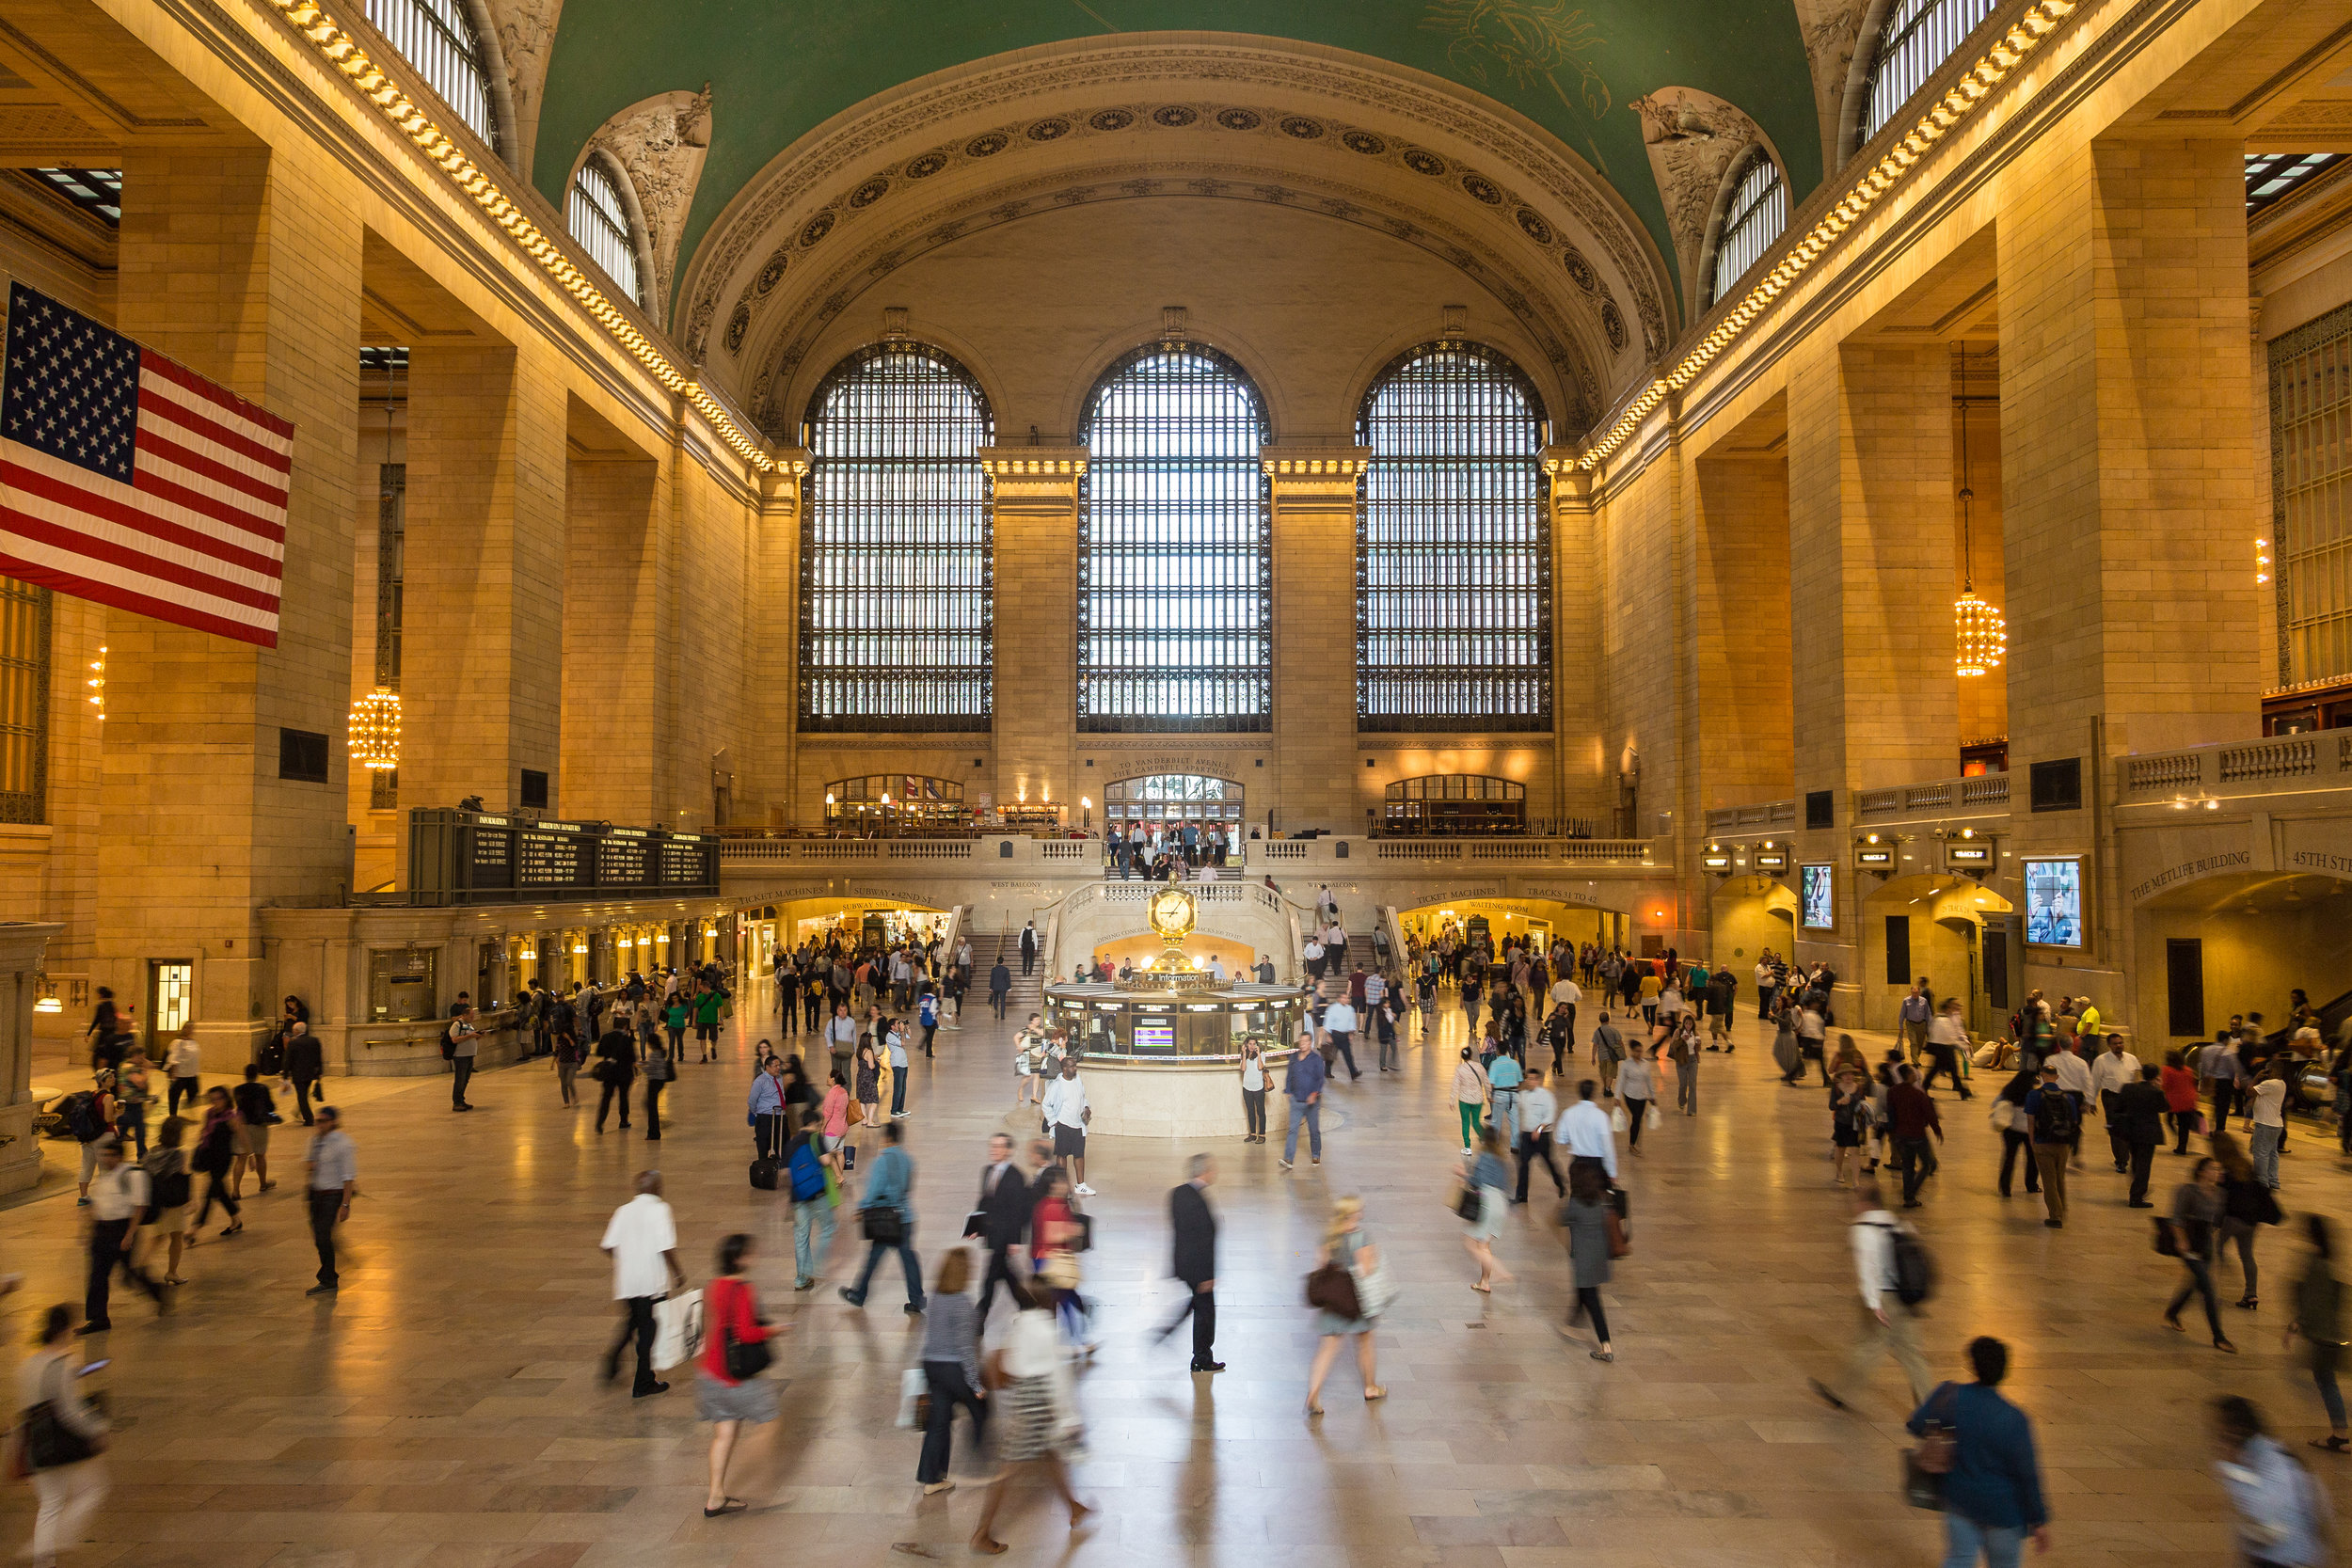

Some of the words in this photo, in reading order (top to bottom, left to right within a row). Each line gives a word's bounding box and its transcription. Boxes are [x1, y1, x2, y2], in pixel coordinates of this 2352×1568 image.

[1136, 757, 1190, 766] VANDERBILT
[1195, 758, 1231, 769] AVENUE
[1113, 769, 1130, 779] THE
[1135, 765, 1180, 774] CAMPBELL
[1185, 765, 1237, 779] APARTMENT
[2293, 851, 2327, 867] 45TH
[2130, 881, 2151, 900] THE
[2152, 863, 2195, 889] METLIFE
[2196, 851, 2250, 872] BUILDING
[739, 893, 772, 904] TICKET
[775, 887, 824, 897] MACHINES
[854, 888, 890, 896] SUBWAY
[898, 892, 920, 901] 42ND
[1417, 893, 1447, 904] TICKET
[1451, 888, 1496, 898] MACHINES
[1528, 888, 1562, 896] TRACKS
[1097, 932, 1120, 942] DINING
